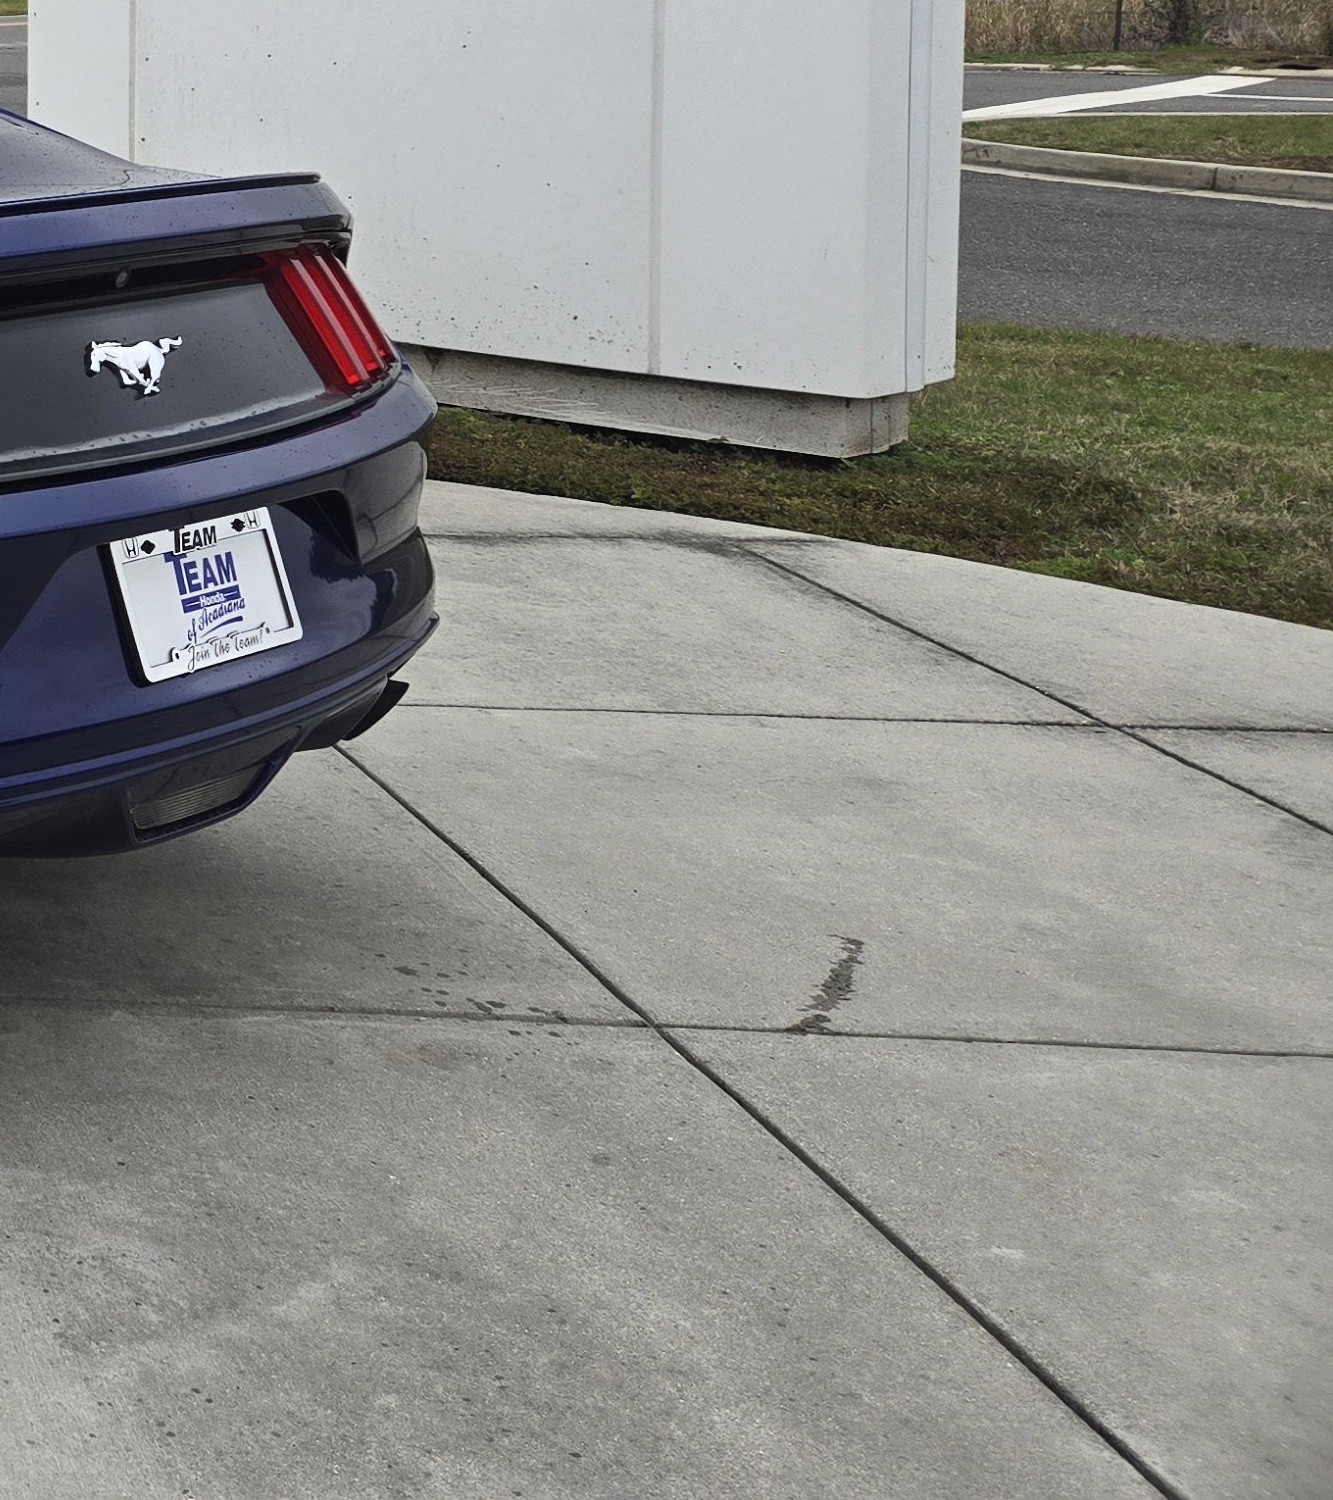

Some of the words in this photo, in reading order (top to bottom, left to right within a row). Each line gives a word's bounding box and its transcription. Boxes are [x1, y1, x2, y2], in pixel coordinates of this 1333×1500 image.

[168, 525, 217, 553] TEAM
[164, 551, 237, 595] TEAM
[198, 597, 245, 631] Acadiana
[188, 645, 210, 671] Join
